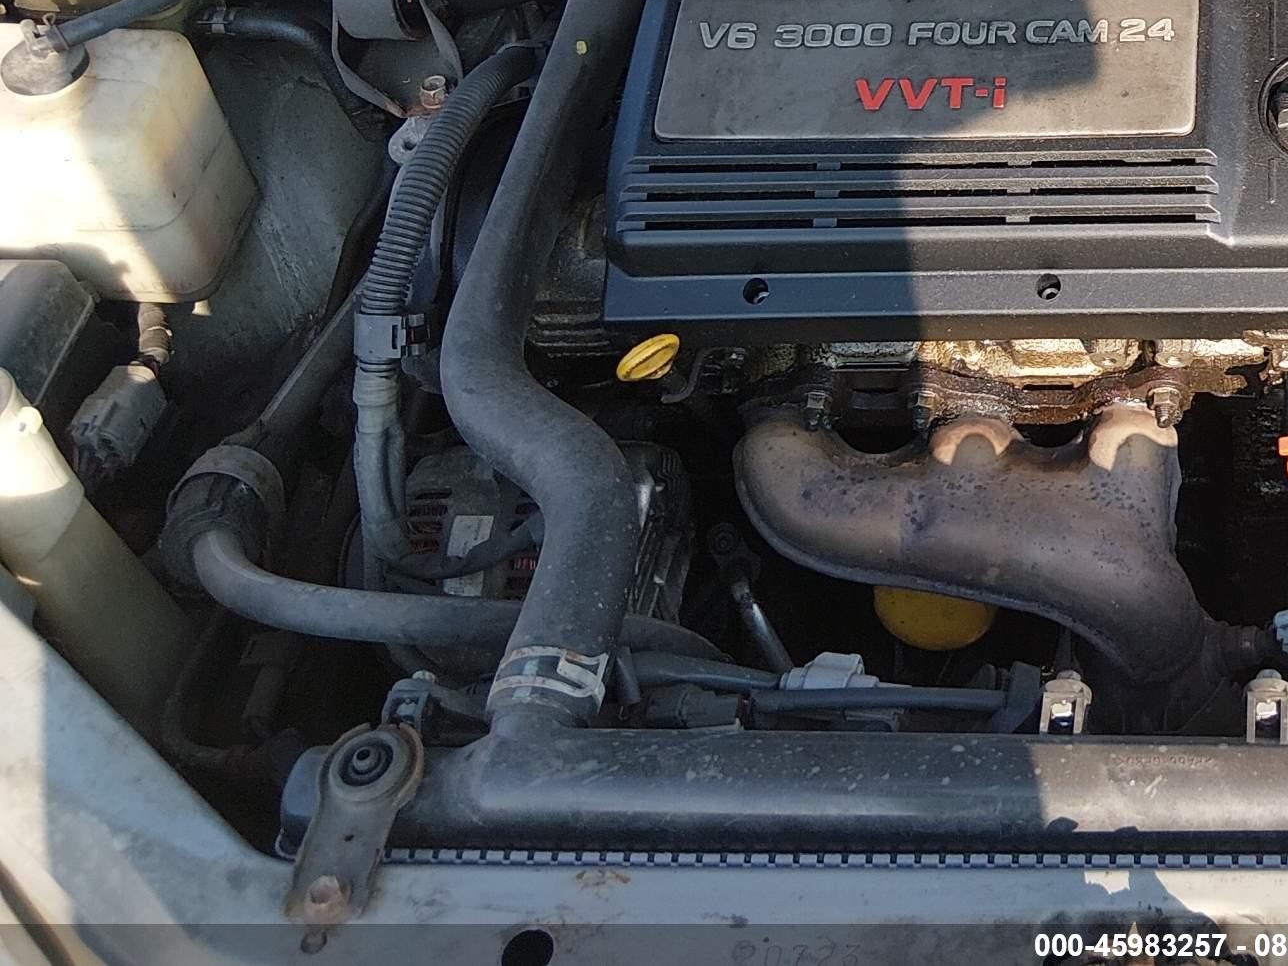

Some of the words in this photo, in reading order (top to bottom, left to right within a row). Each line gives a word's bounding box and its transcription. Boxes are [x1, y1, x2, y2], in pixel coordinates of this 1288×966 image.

[699, 22, 758, 49] V6
[773, 22, 893, 48] 3000
[907, 21, 1017, 46] FOUR
[1025, 19, 1108, 44] CAM
[1118, 18, 1175, 43] 24
[855, 77, 1007, 111] VVT-i
